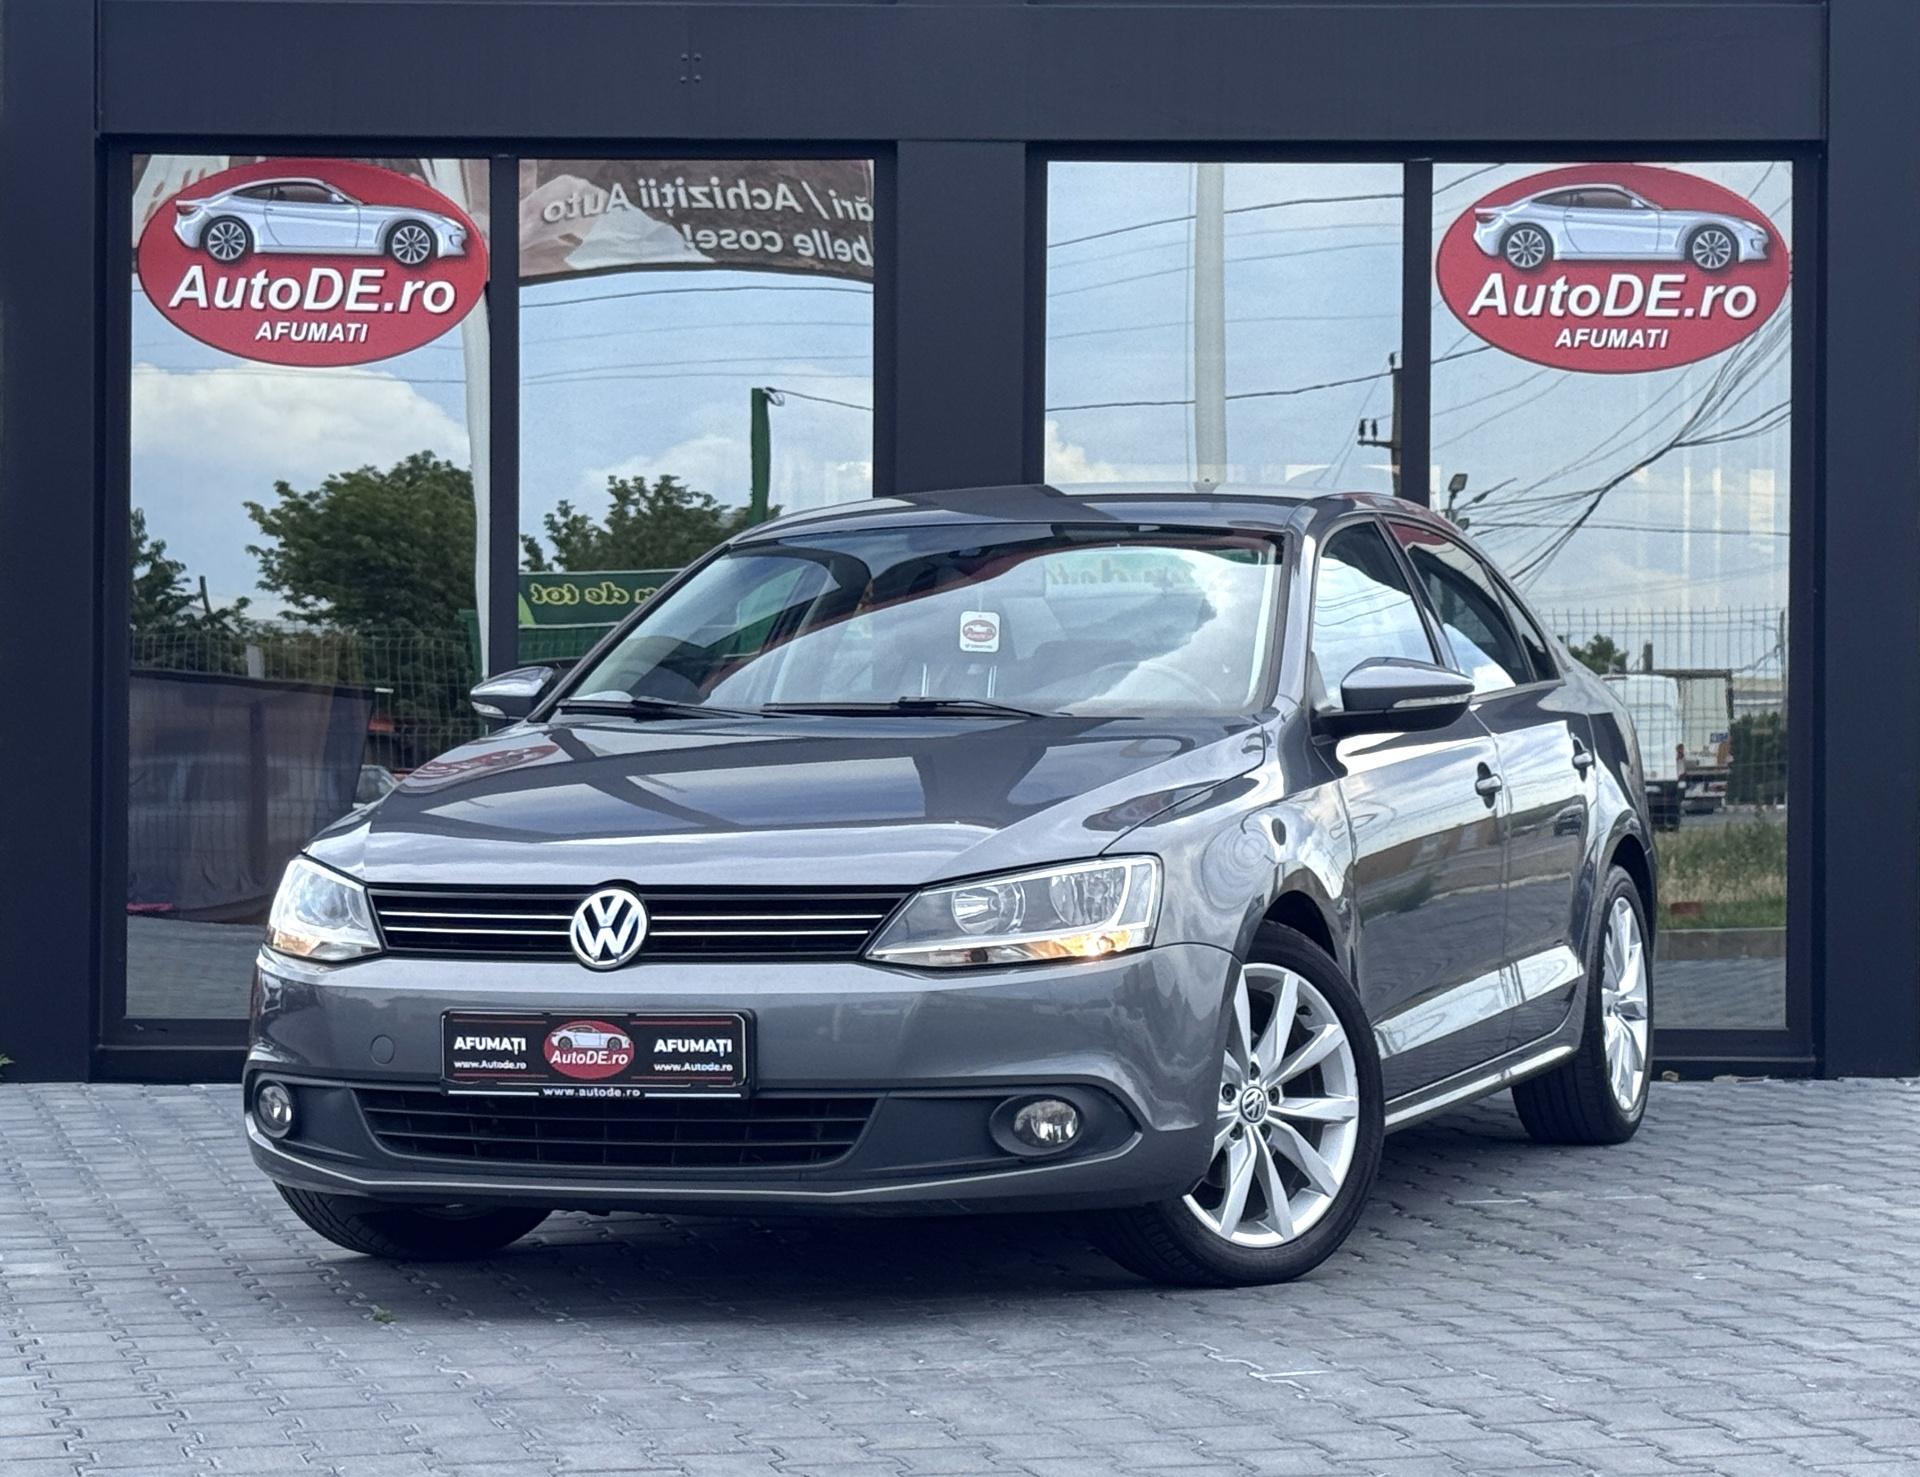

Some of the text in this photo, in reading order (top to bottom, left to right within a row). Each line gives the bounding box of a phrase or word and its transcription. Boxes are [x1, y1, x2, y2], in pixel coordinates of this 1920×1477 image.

[168, 265, 457, 314] AutoDE.ro
[1467, 272, 1758, 319] AutoDE.ro
[255, 321, 369, 343] AFUMATI
[1554, 328, 1669, 349] AFUMATI
[569, 888, 648, 968] VW
[549, 1049, 629, 1066] AutoDE.ro
[542, 1086, 641, 1098] www.autode.ro
